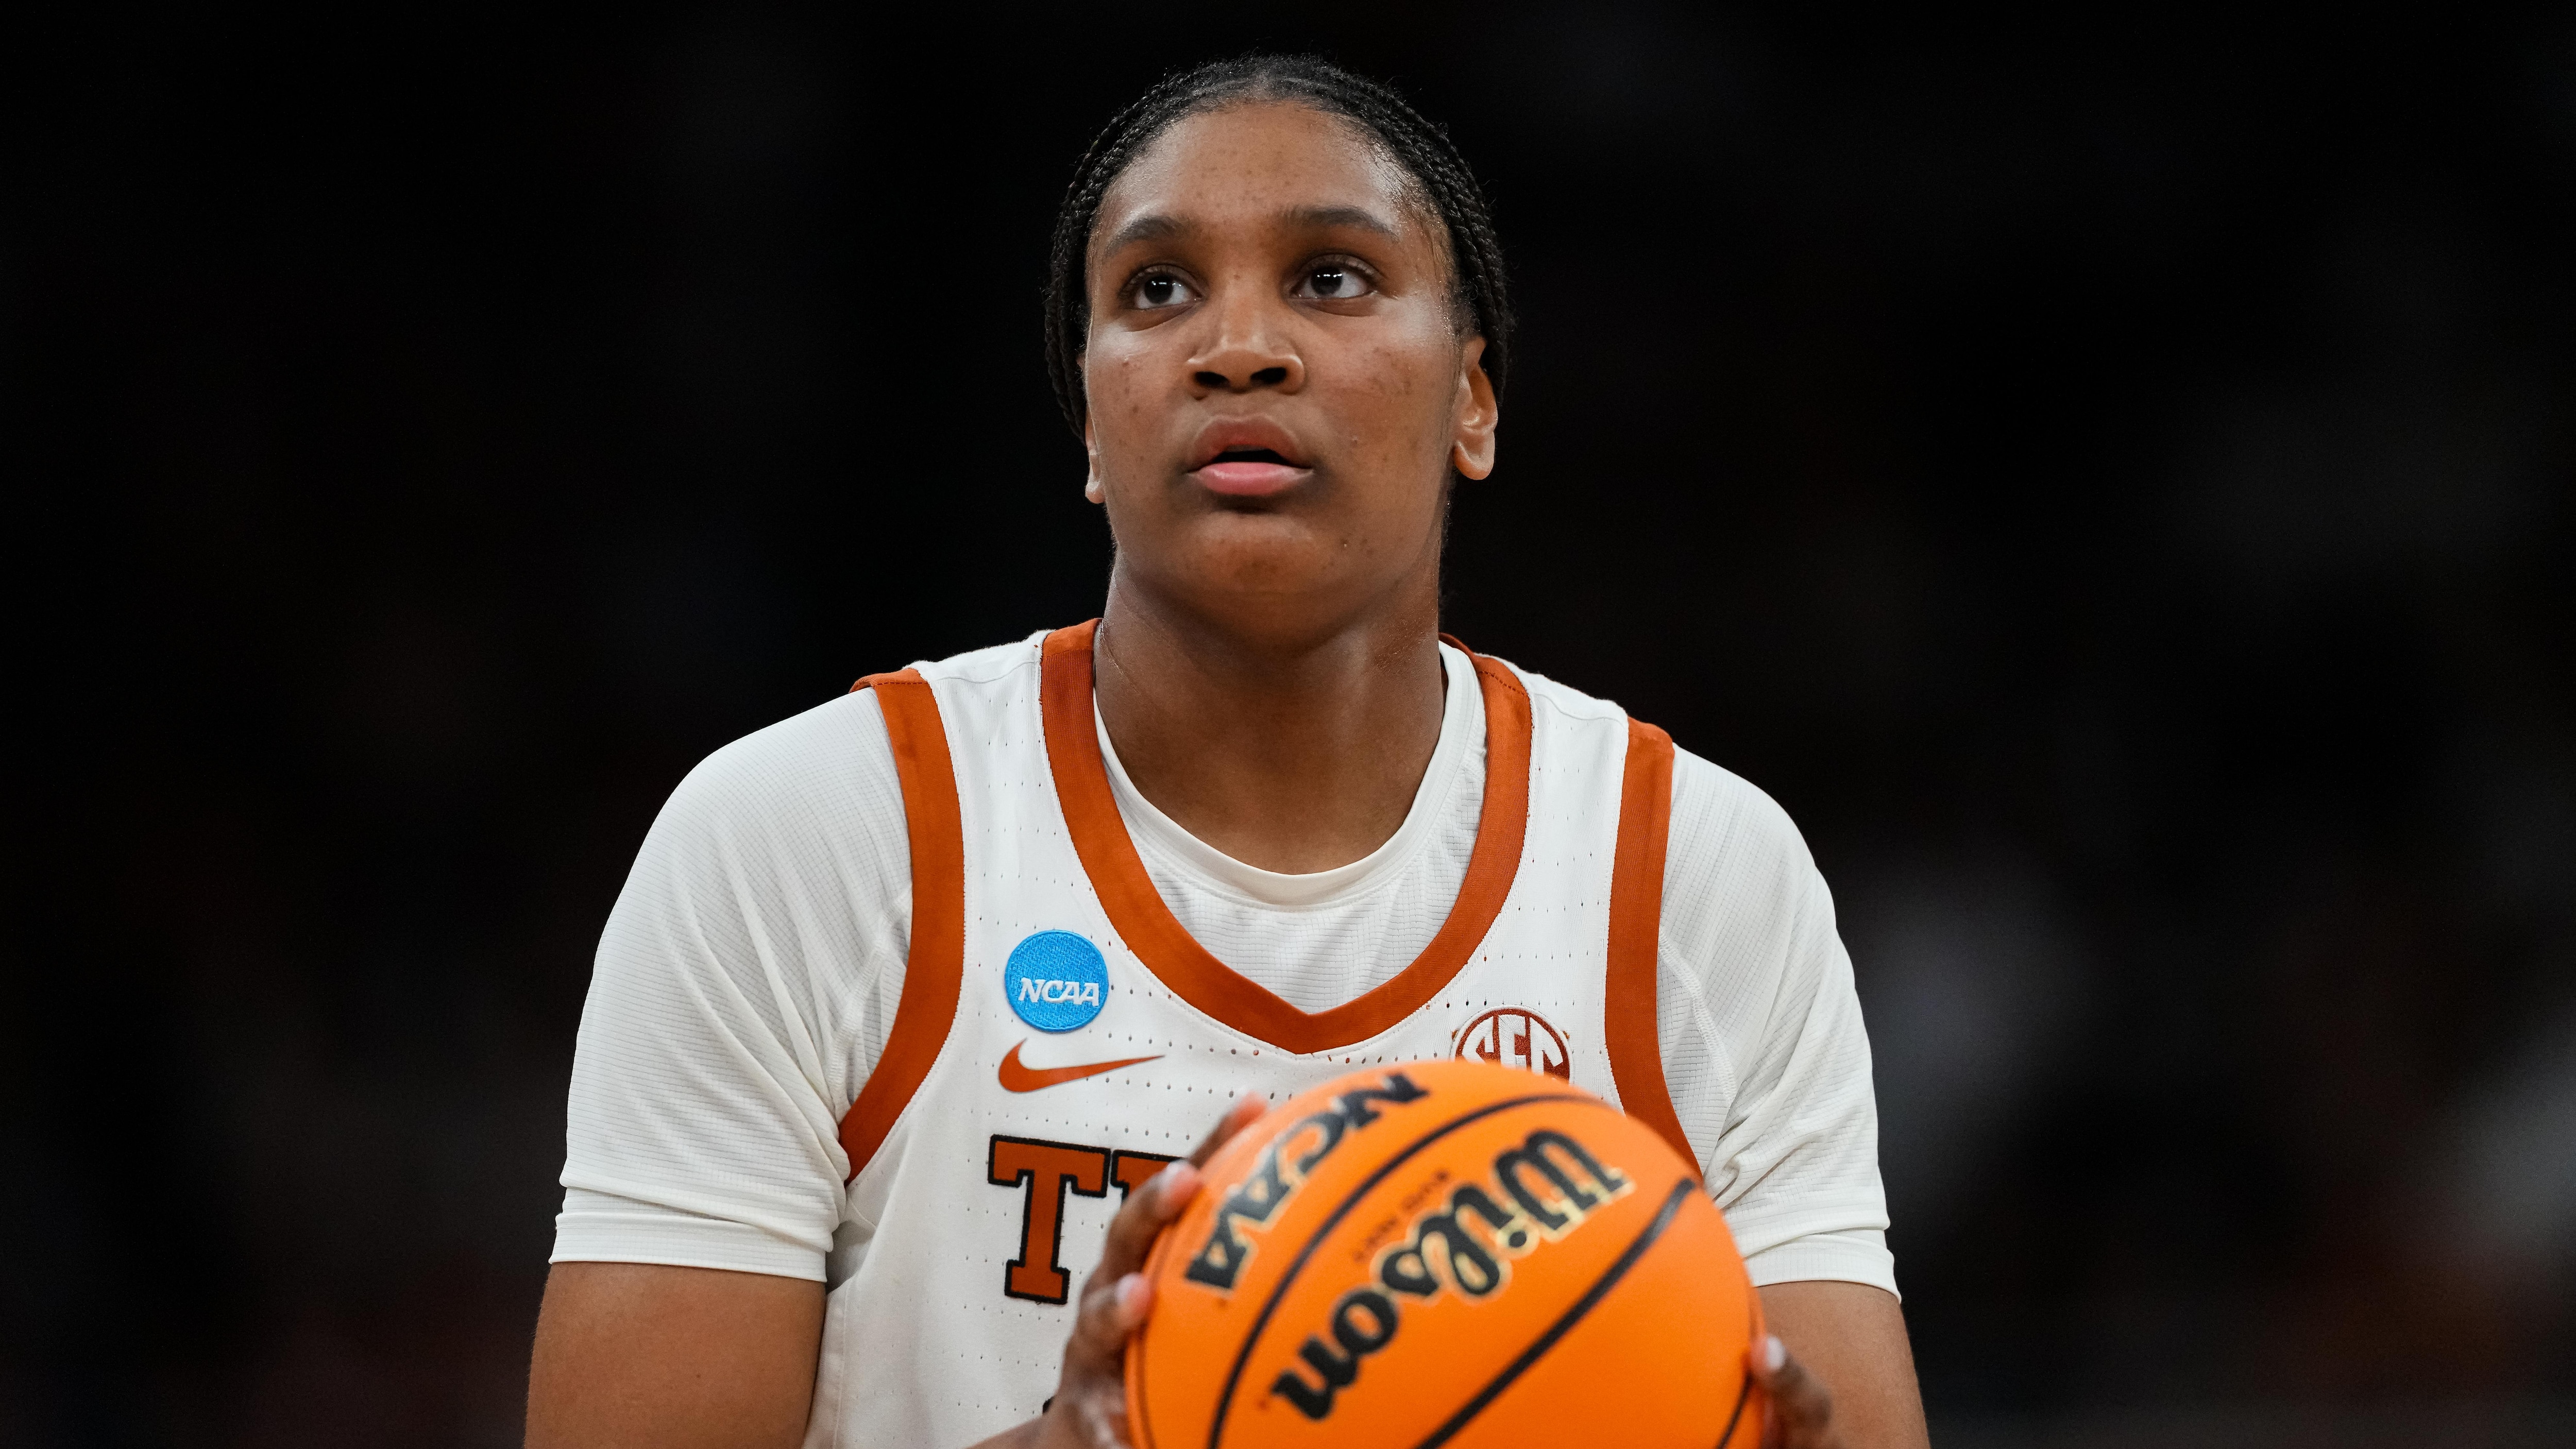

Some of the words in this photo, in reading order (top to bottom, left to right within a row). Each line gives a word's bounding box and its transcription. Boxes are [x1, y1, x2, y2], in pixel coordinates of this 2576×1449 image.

[1018, 977, 1099, 1007] NCAA
[1185, 1072, 1431, 1292] NCAA
[1270, 1128, 1635, 1422] Wilson
